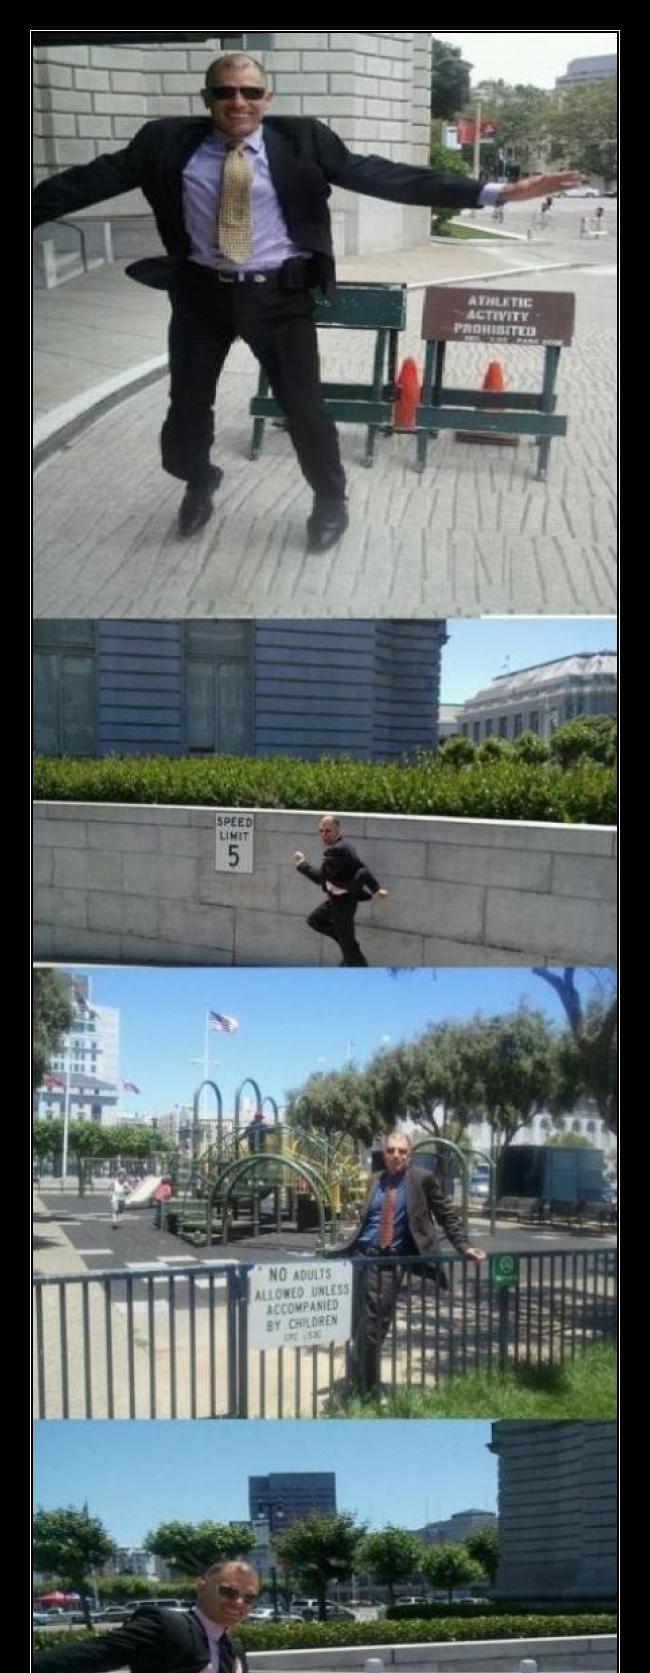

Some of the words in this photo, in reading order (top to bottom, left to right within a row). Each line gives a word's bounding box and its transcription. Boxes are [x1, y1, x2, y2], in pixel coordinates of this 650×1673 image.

[468, 295, 533, 308] ATHLETIC
[466, 309, 529, 322] ACTIVITY
[453, 322, 537, 337] PROHIBITED
[216, 816, 252, 828] SPEED
[219, 831, 248, 841] LIMIT
[228, 844, 239, 867] 5
[269, 1267, 287, 1281] NO
[293, 1268, 332, 1281] ADULTS
[255, 1286, 304, 1301] ALLOWED
[311, 1283, 350, 1297] UNLESS
[266, 1299, 339, 1316] ACCOMPANIED
[266, 1320, 281, 1332] BY
[289, 1315, 338, 1330] CHILDREN
